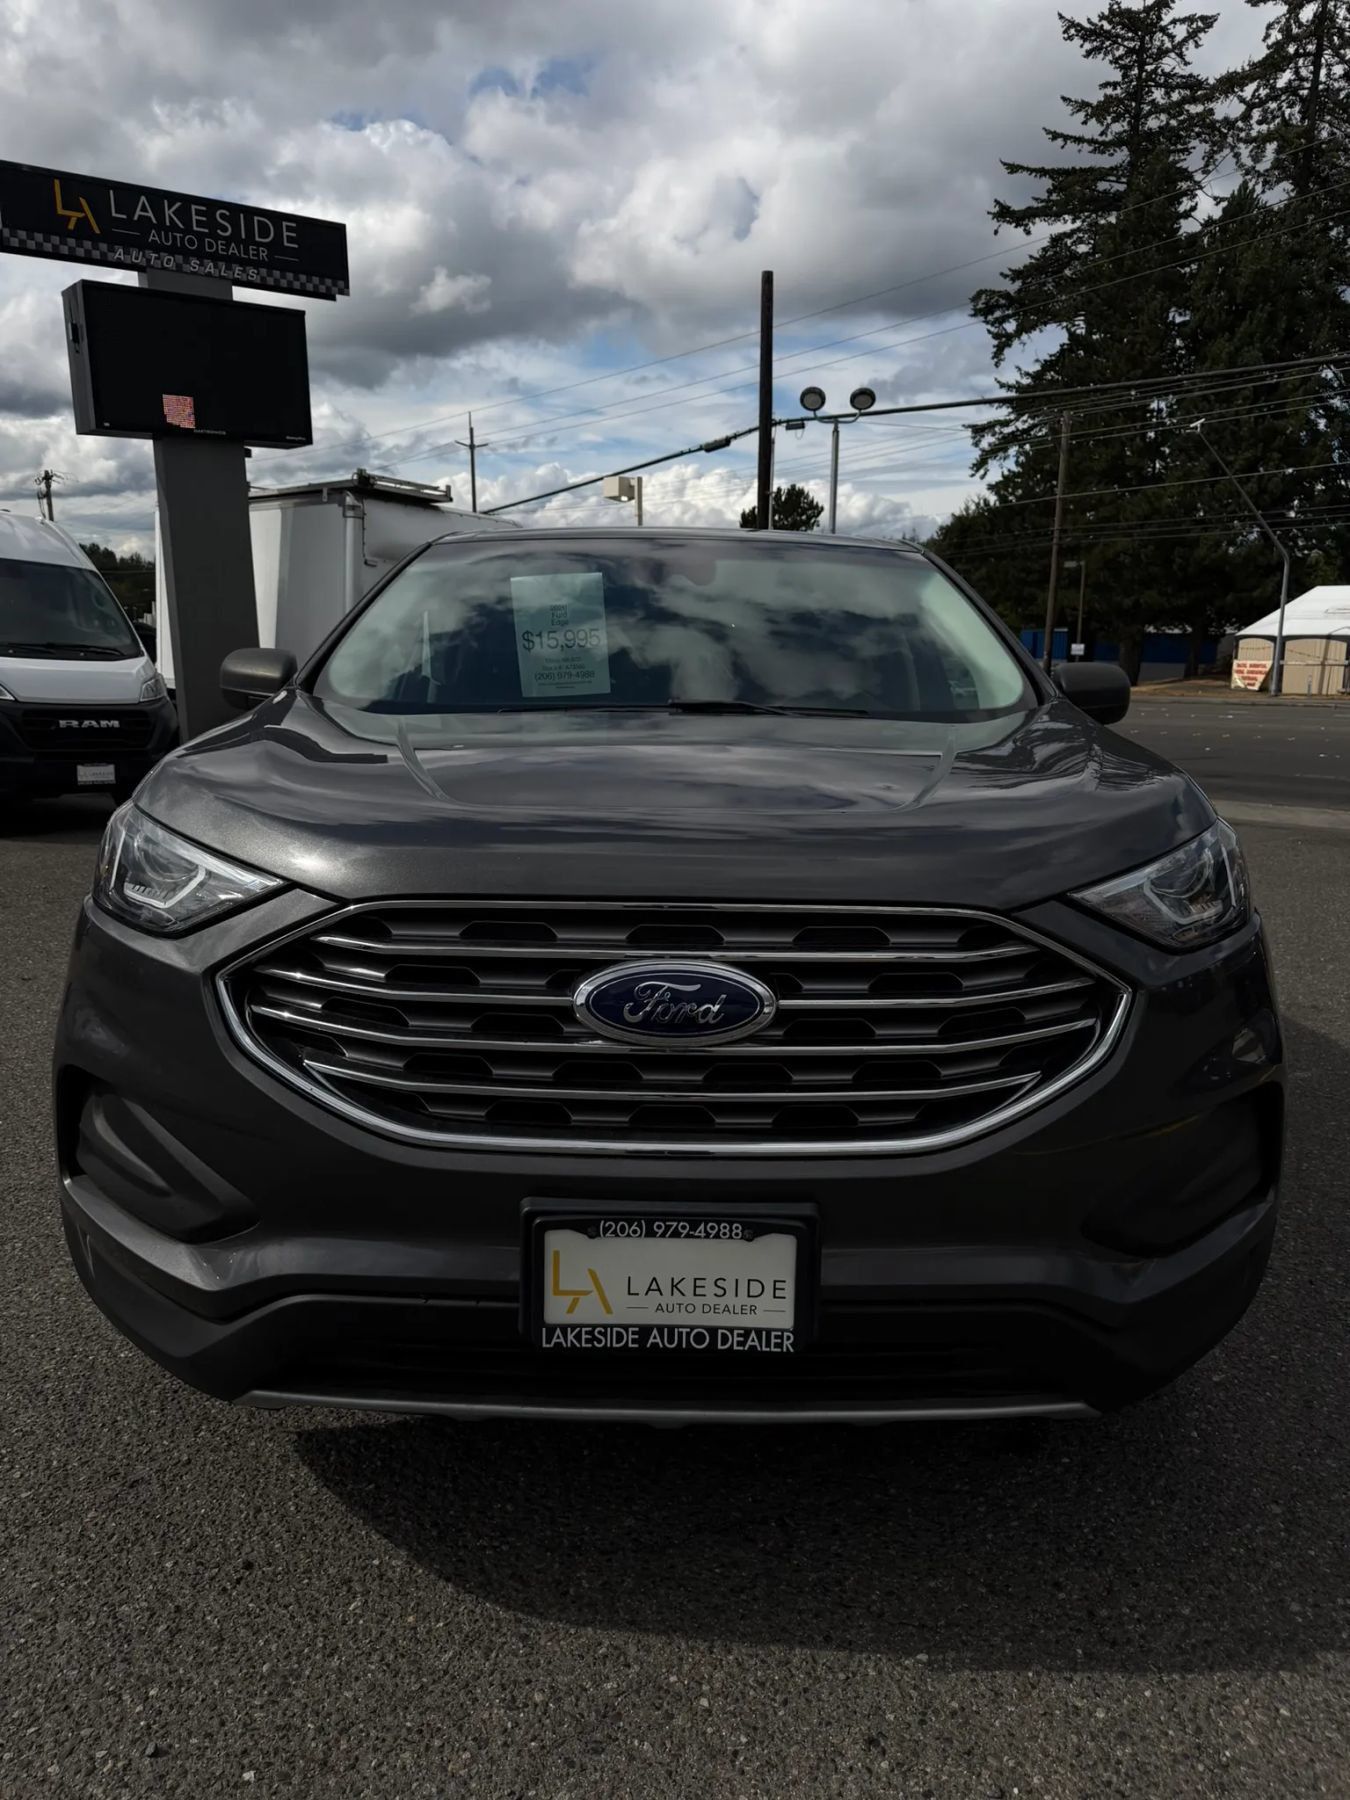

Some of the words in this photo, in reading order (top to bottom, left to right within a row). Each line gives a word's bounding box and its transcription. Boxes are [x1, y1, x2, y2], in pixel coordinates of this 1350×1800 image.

[109, 190, 299, 248] LAKESIDE
[148, 228, 198, 249] AUTO
[204, 238, 268, 261] DEALER
[114, 248, 175, 268] AUTO
[190, 259, 258, 281] SALES
[522, 628, 601, 652] $15,995
[59, 720, 120, 728] RAM
[623, 981, 727, 1024] Ford
[600, 1220, 646, 1239] (206)
[653, 1221, 743, 1240] 979-4988
[627, 1276, 787, 1299] LAKESIDE
[655, 1303, 696, 1314] AUTO
[702, 1303, 758, 1316] DEALER
[542, 1327, 640, 1348] LAKESIDE
[647, 1327, 710, 1349] AUTO
[717, 1330, 795, 1353] DEALER
